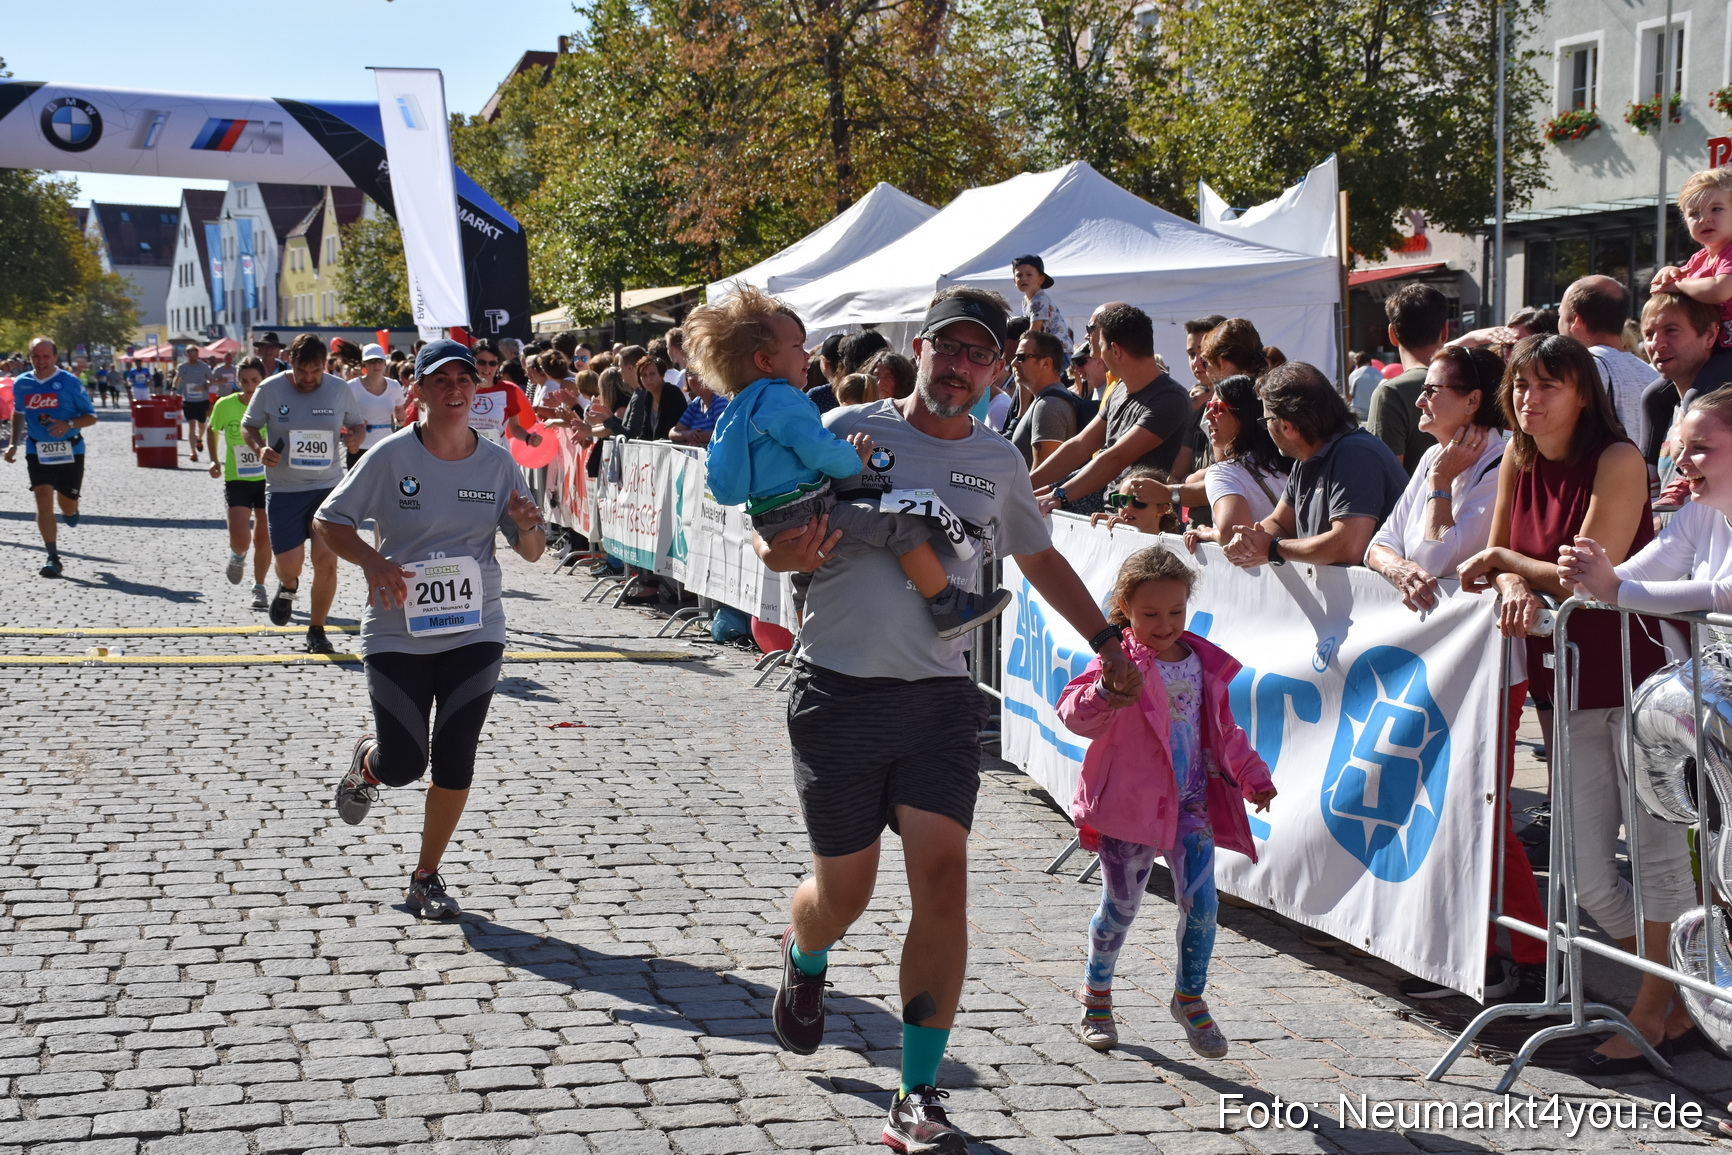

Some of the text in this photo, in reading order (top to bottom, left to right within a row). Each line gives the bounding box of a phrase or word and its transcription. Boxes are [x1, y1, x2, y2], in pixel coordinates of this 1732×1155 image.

[457, 205, 503, 240] MARKT
[25, 393, 58, 409] Lete
[41, 442, 66, 453] 2073
[296, 441, 327, 454] 2490
[861, 474, 894, 484] PARTL
[951, 472, 995, 494] BOCK
[458, 489, 496, 501] BOCK
[898, 499, 966, 545] 2159
[425, 565, 460, 576] BOCK
[415, 577, 473, 606] 2014
[440, 604, 463, 612] Neumarkt
[429, 615, 465, 627] Martina
